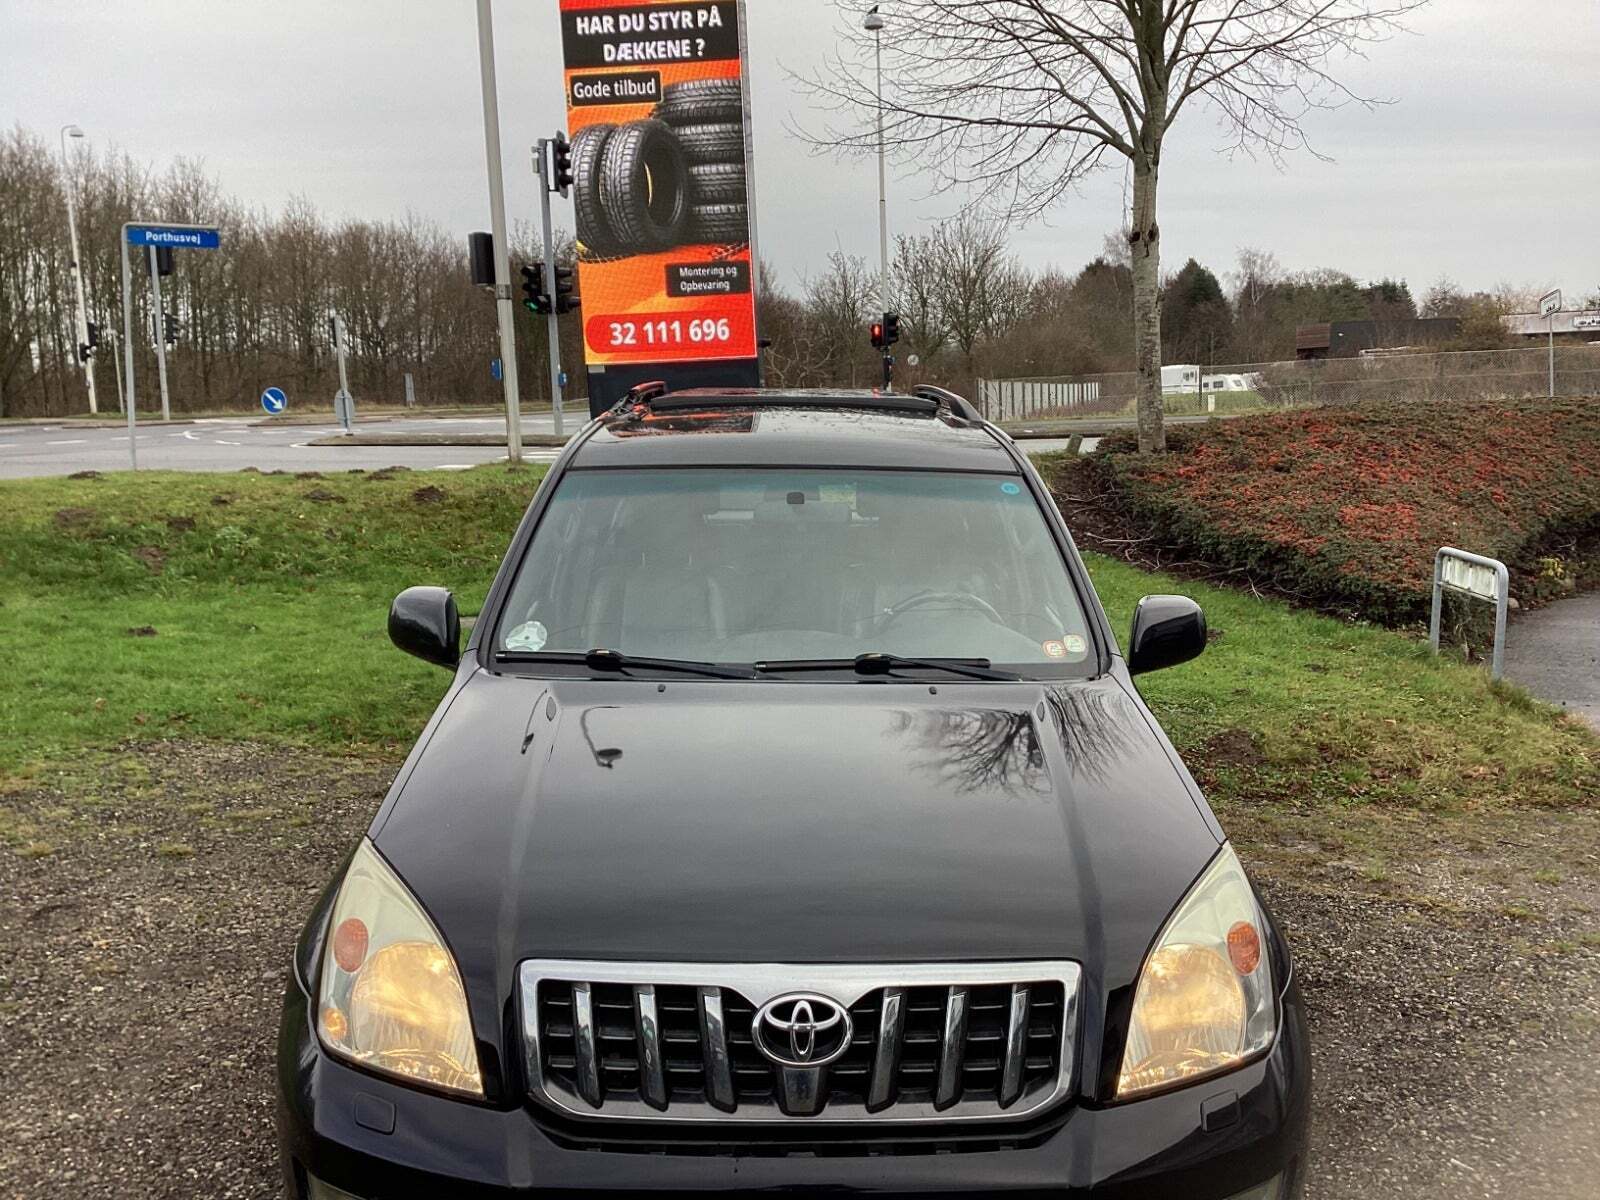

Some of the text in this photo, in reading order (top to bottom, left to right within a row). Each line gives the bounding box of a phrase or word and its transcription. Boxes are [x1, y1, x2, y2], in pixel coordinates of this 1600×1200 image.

[576, 5, 722, 35] HAR DU STYR PÅ
[603, 38, 706, 61] DÆKKENE ?
[573, 78, 656, 98] Gode tilbud
[145, 231, 201, 245] Porthusvej
[679, 266, 737, 277] Montering og
[680, 280, 730, 291] Opbevaring
[609, 318, 730, 345] 32 111 696
